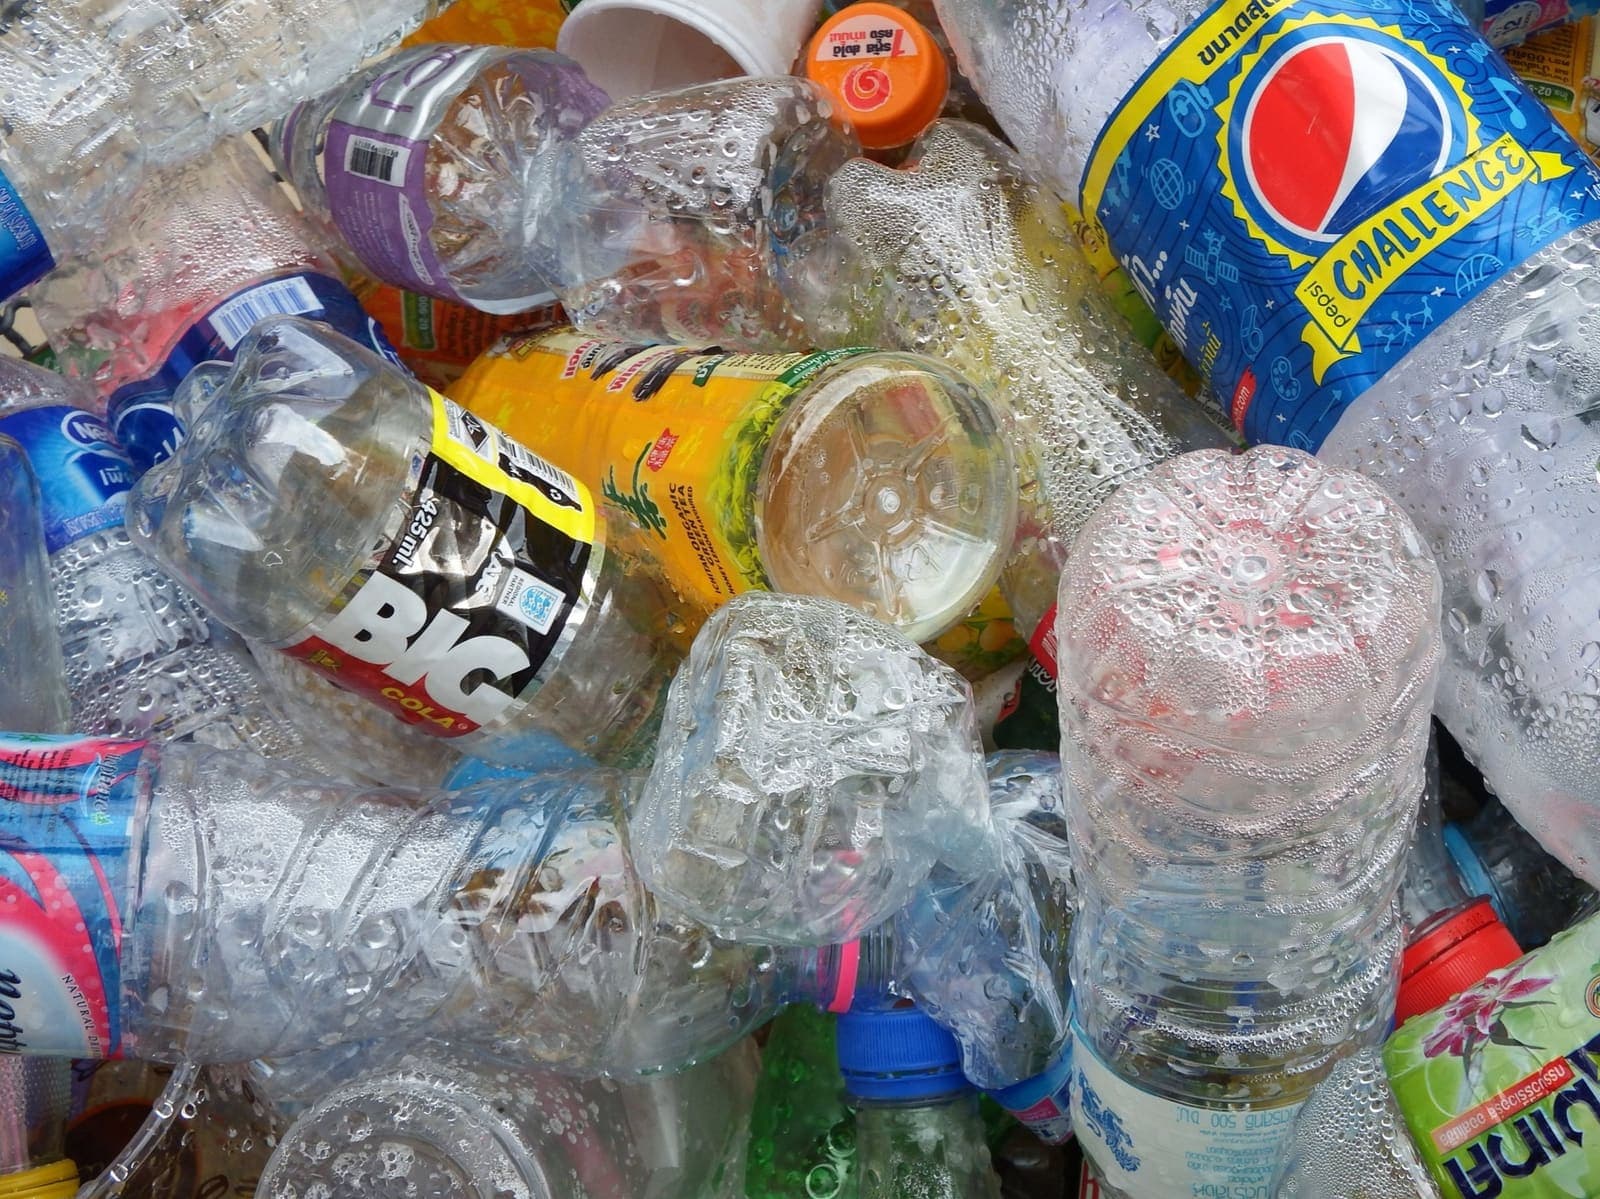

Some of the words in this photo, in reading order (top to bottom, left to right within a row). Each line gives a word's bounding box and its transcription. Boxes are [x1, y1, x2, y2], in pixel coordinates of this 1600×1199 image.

[1333, 146, 1525, 301] CHALLENGE
[1304, 281, 1351, 328] pepsi
[669, 483, 701, 551] ORGANIC
[677, 485, 690, 515] TEA
[690, 519, 715, 567] GREEN
[697, 553, 721, 594] ICHITAN
[322, 570, 531, 726] BIG
[381, 687, 456, 729] COLA
[62, 975, 95, 1030] NATURAL
[1211, 1113, 1237, 1129] 500
